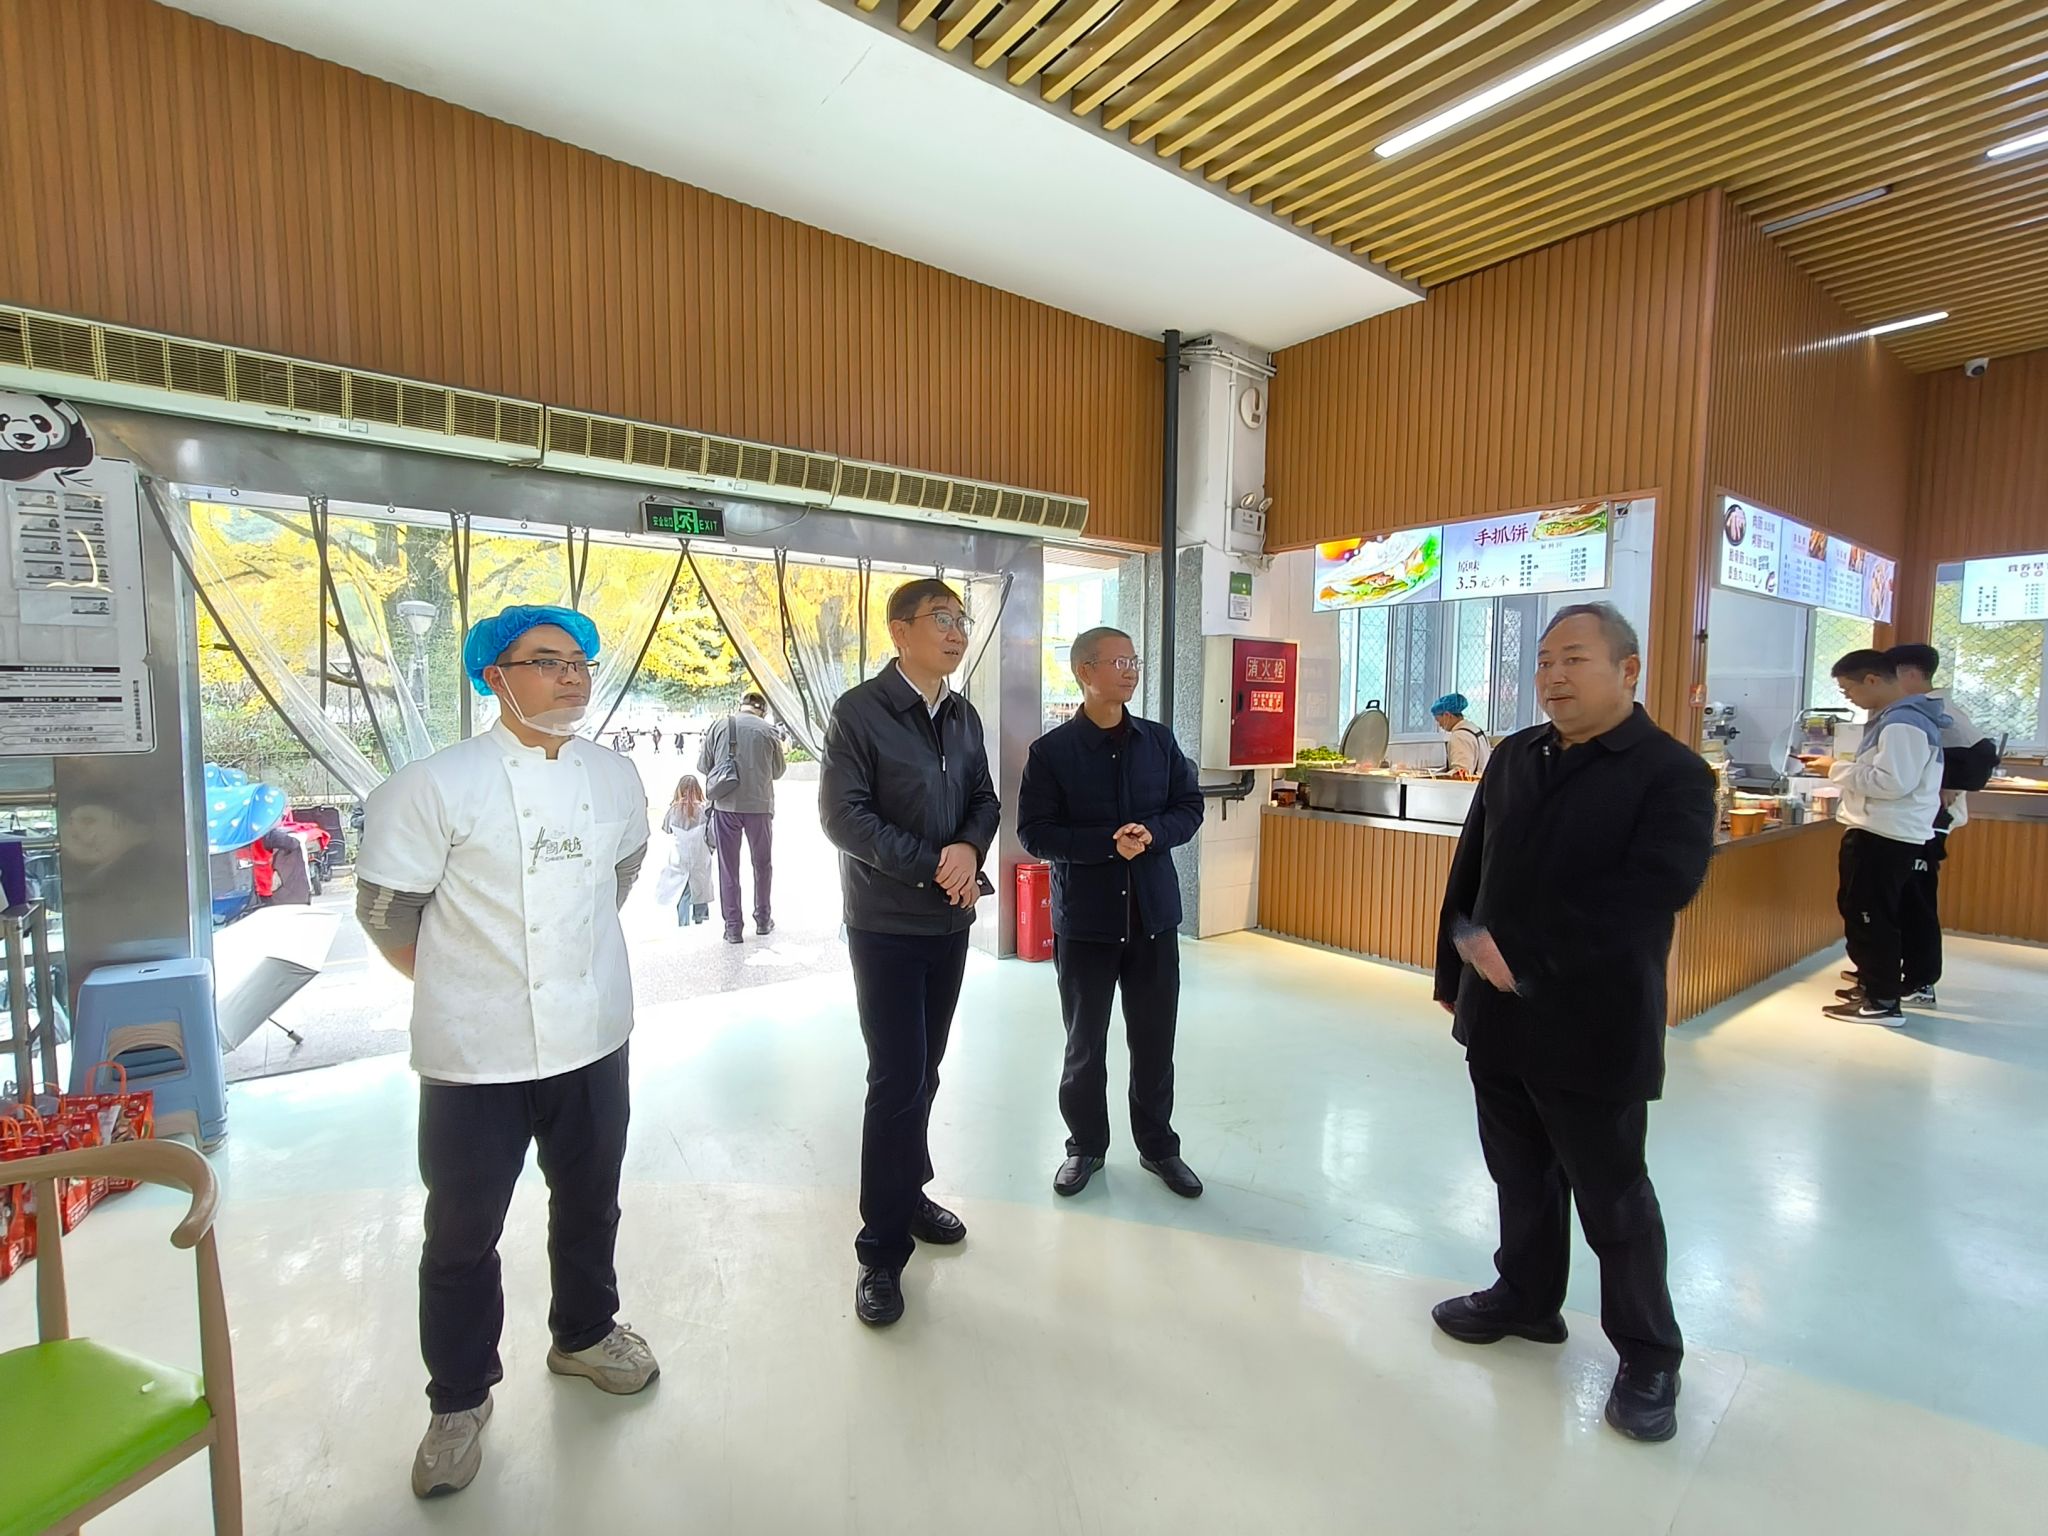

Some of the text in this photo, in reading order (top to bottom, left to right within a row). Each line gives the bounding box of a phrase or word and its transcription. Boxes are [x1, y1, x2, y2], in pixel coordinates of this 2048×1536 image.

[699, 519, 718, 531] EXIT
[1474, 523, 1528, 546] 手抓饼
[1457, 559, 1480, 573] 原味
[1456, 574, 1510, 590] 3.5元/个
[1248, 659, 1283, 678] 消火栓
